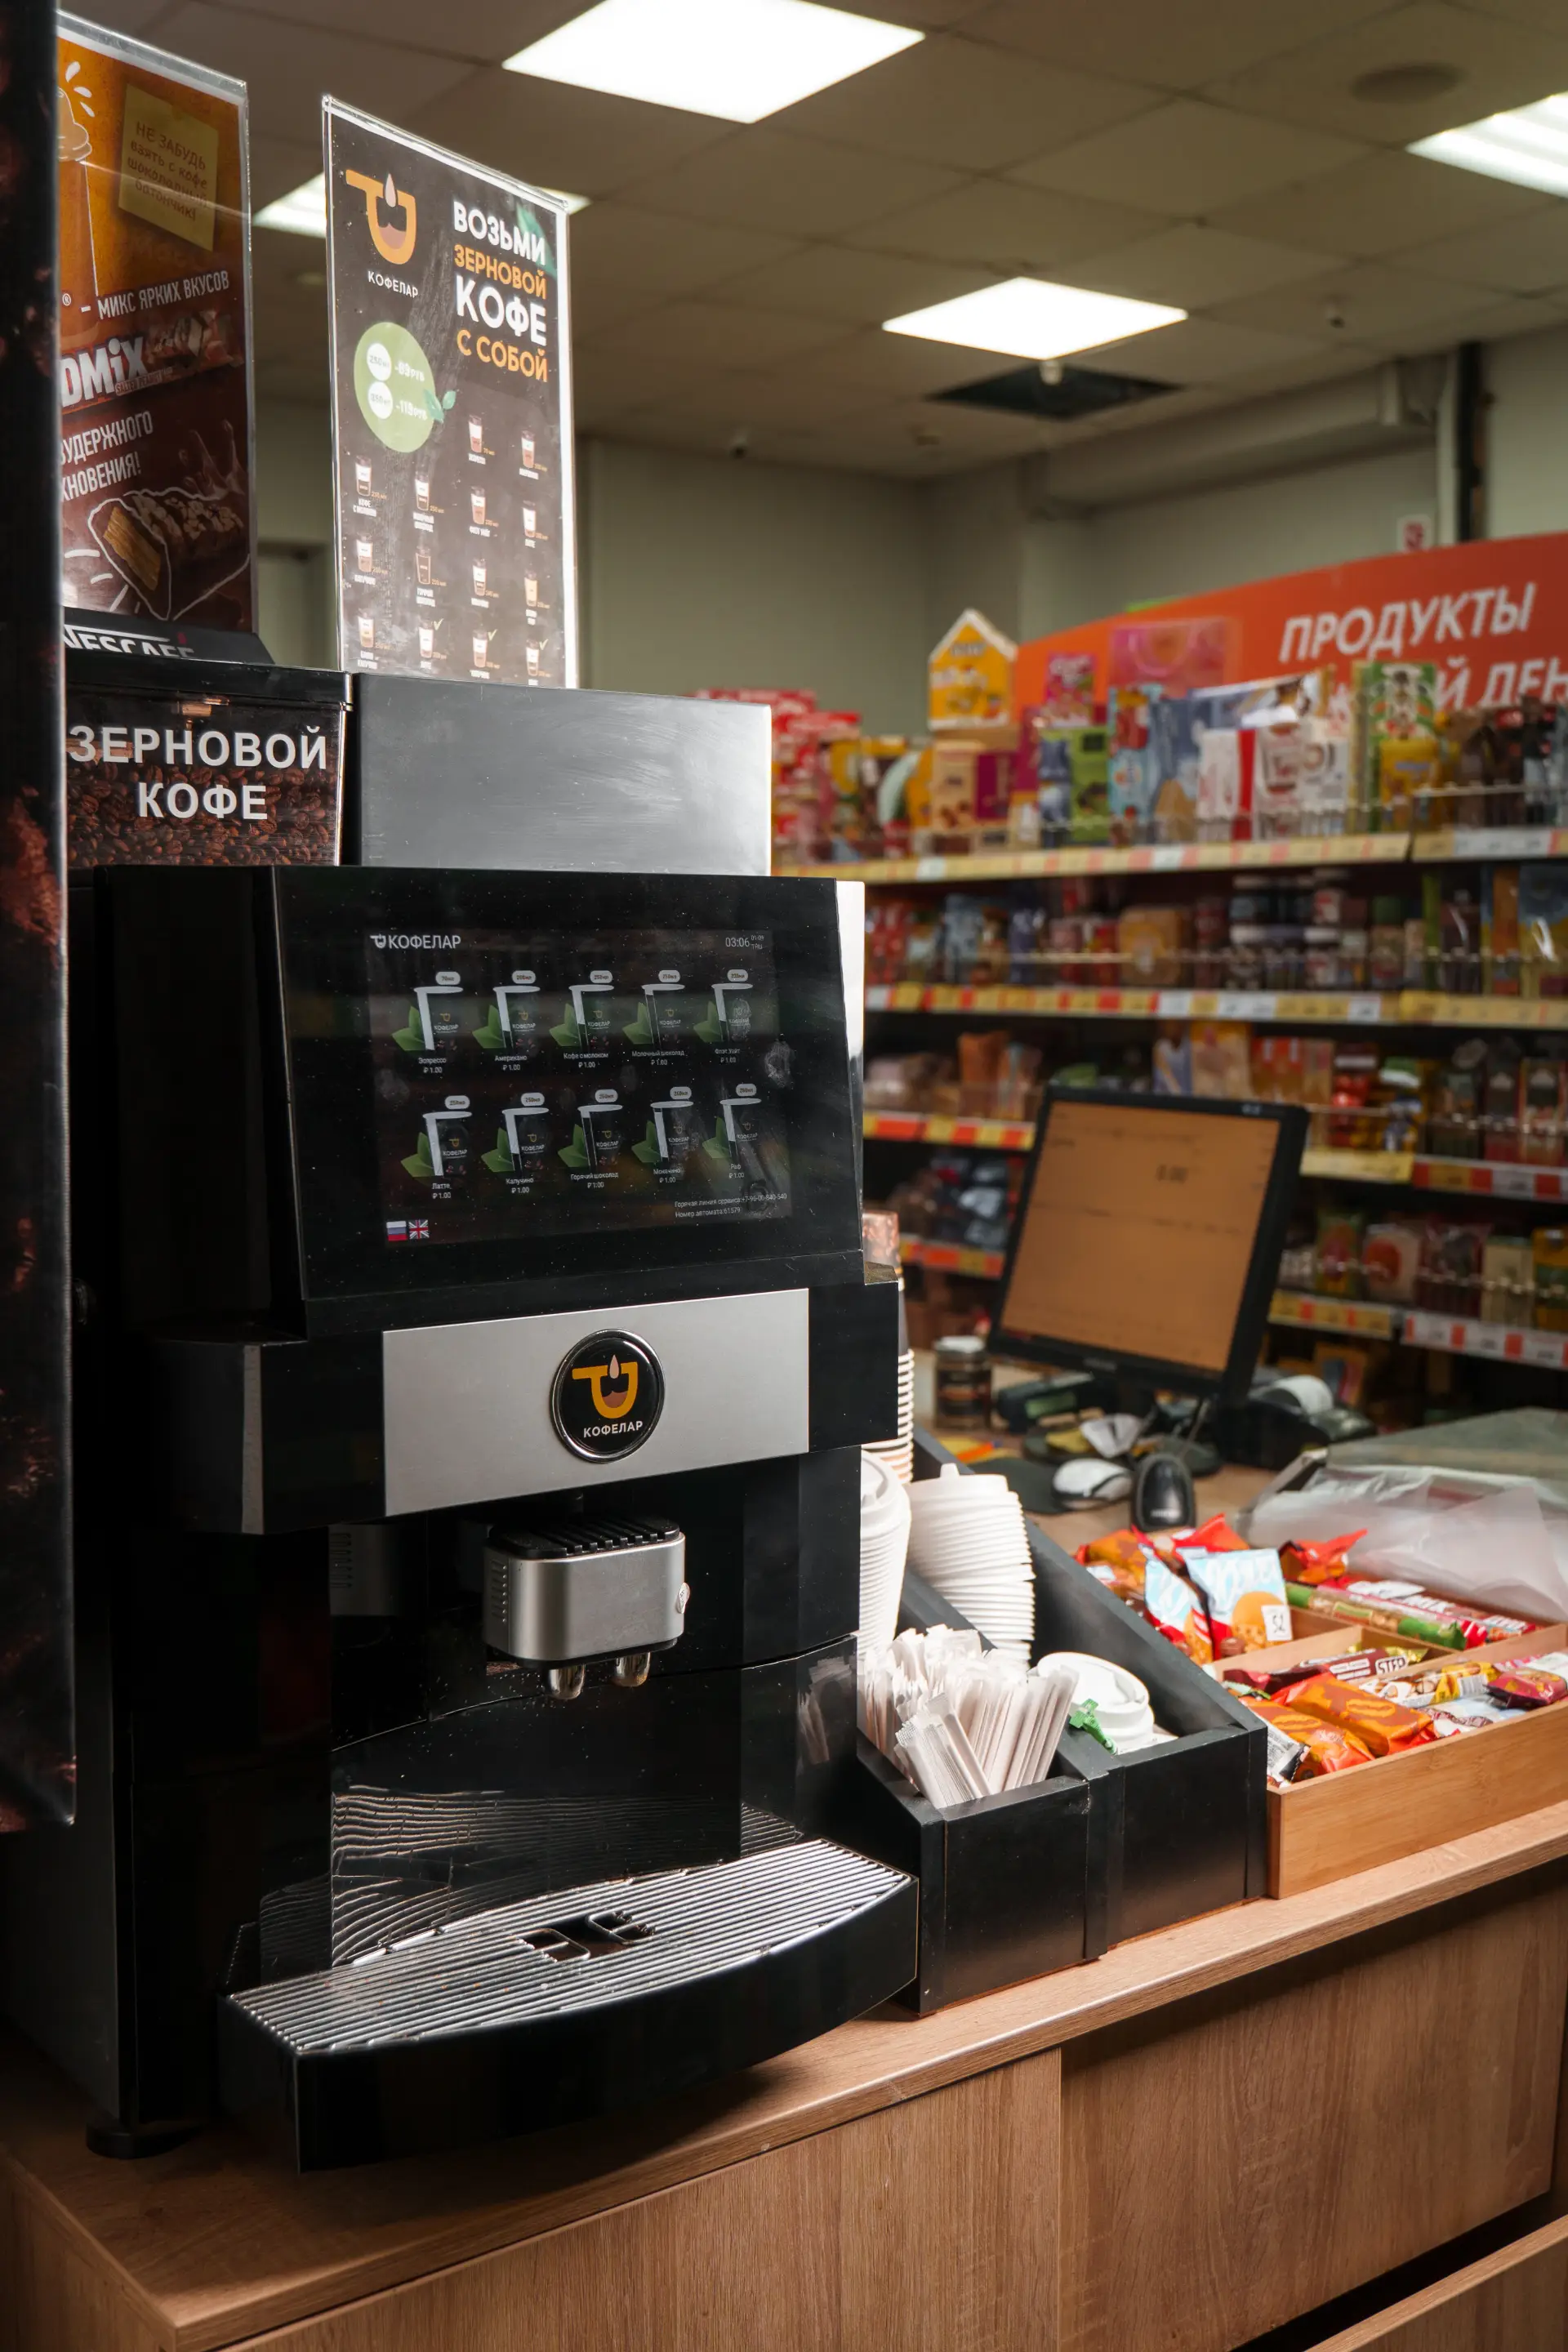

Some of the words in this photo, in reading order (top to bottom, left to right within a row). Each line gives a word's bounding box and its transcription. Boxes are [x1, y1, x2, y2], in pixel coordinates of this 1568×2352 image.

[130, 140, 164, 167] взять
[179, 167, 207, 189] кофе
[136, 121, 156, 143] НЕ
[158, 134, 206, 171] ЗАБУДЬ
[452, 200, 546, 266] ВОЗЬМИ
[368, 270, 419, 300] КОФЕЛАР
[454, 243, 547, 301] ЗЕРНОВОЙ
[97, 292, 136, 320] МИКС
[139, 281, 181, 310] ЯРКИХ
[183, 270, 229, 299] ВКУСОВ
[455, 274, 547, 347] КОФЕ
[457, 328, 472, 356] С
[476, 335, 548, 383] СОБОЙ
[1279, 581, 1536, 662] ПРОДУКТЫ
[69, 724, 327, 769] ЗЕРНОВОЙ
[137, 782, 269, 820] КОФЕ
[389, 934, 461, 950] КОФЕЛАР
[725, 937, 750, 947] 03:06
[495, 1054, 528, 1062] Американо
[564, 1052, 577, 1060] Кофе
[675, 1200, 697, 1209] Горячая
[698, 1199, 717, 1207] линия
[675, 1210, 695, 1218] Номер
[583, 1419, 644, 1438] КОФЕЛАР
